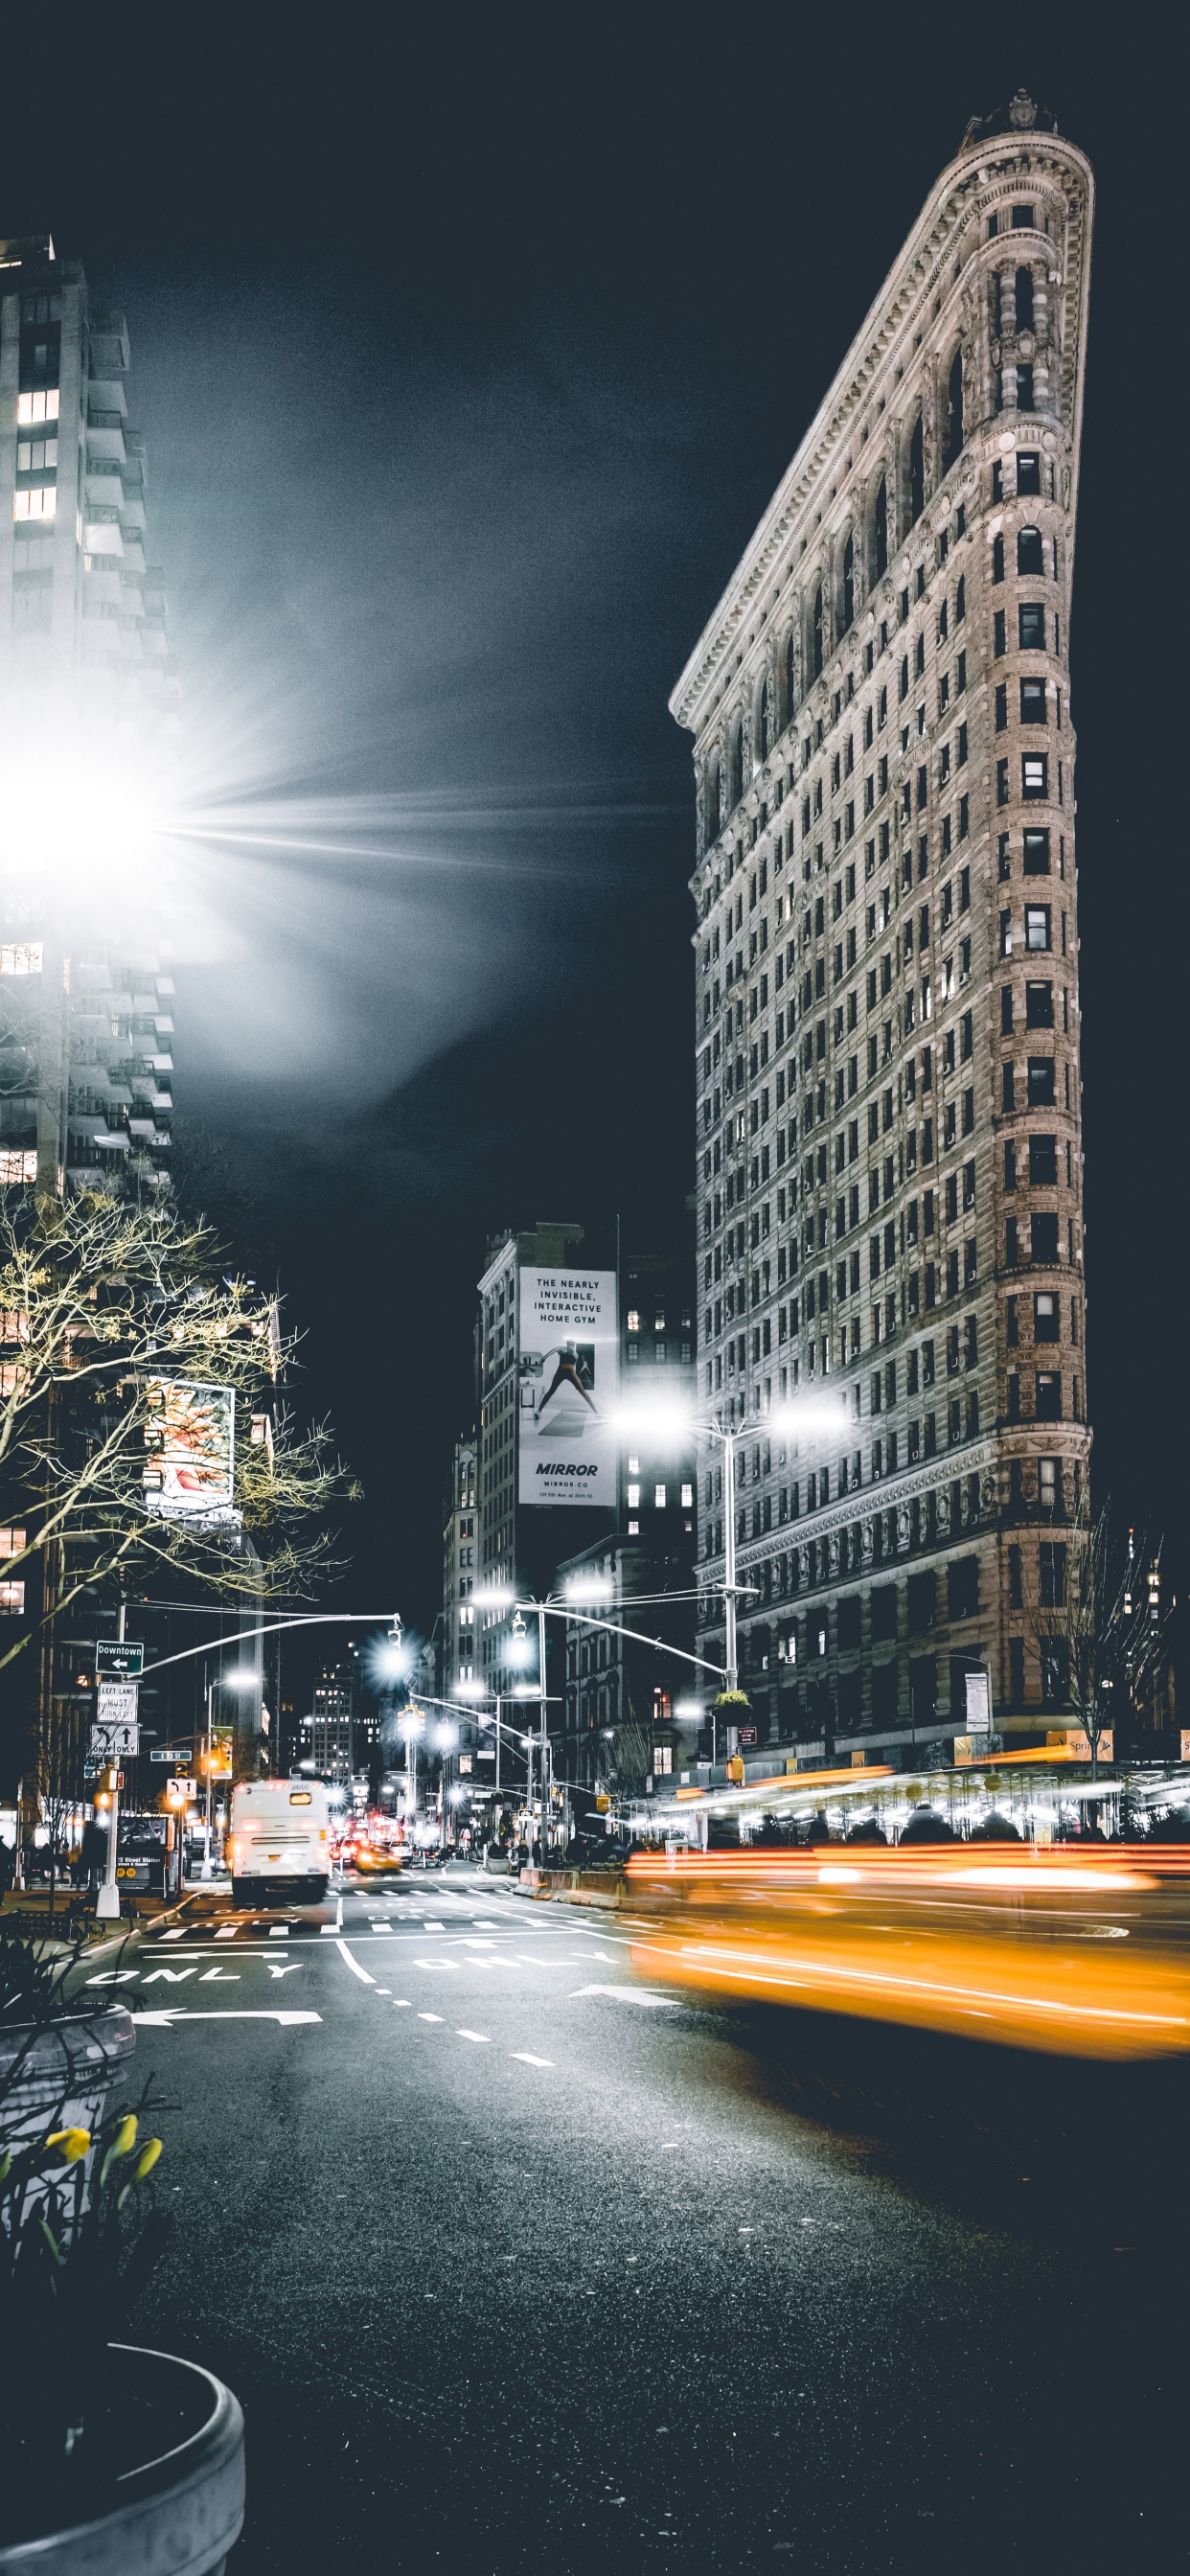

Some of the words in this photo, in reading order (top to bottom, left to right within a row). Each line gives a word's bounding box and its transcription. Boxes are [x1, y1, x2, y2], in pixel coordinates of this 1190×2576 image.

[561, 1280, 599, 1289] NEARLY
[540, 1291, 596, 1301] INVISIBLE,
[534, 1302, 602, 1313] INTERACTIVE
[540, 1314, 569, 1322] HOME
[536, 1463, 598, 1476] MIRROR
[99, 1645, 142, 1656] Downtown
[213, 1905, 303, 1914] ONLY
[368, 1912, 476, 1920] ONLY
[191, 1918, 303, 1928] ONLY
[412, 1951, 622, 1970] ONLY
[84, 1964, 304, 1985] ONLY
